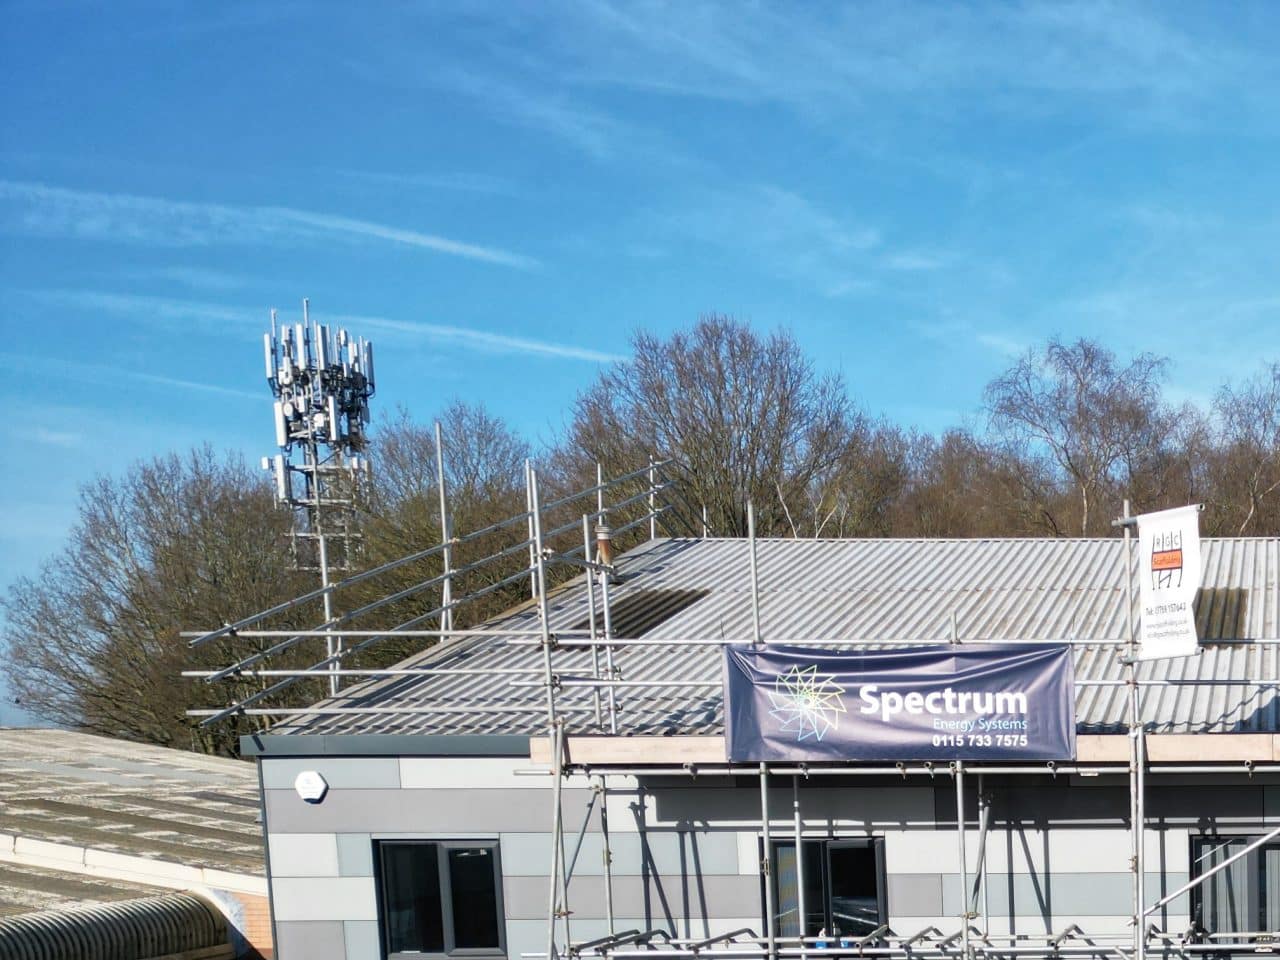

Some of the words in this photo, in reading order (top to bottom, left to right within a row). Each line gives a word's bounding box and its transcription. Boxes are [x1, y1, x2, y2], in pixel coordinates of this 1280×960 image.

[859, 685, 1028, 722] Spectrum
[933, 718, 975, 732] Energy
[978, 718, 1028, 732] Systems
[932, 735, 964, 747] 0115
[968, 735, 992, 747] 733
[996, 734, 1028, 747] 7575
